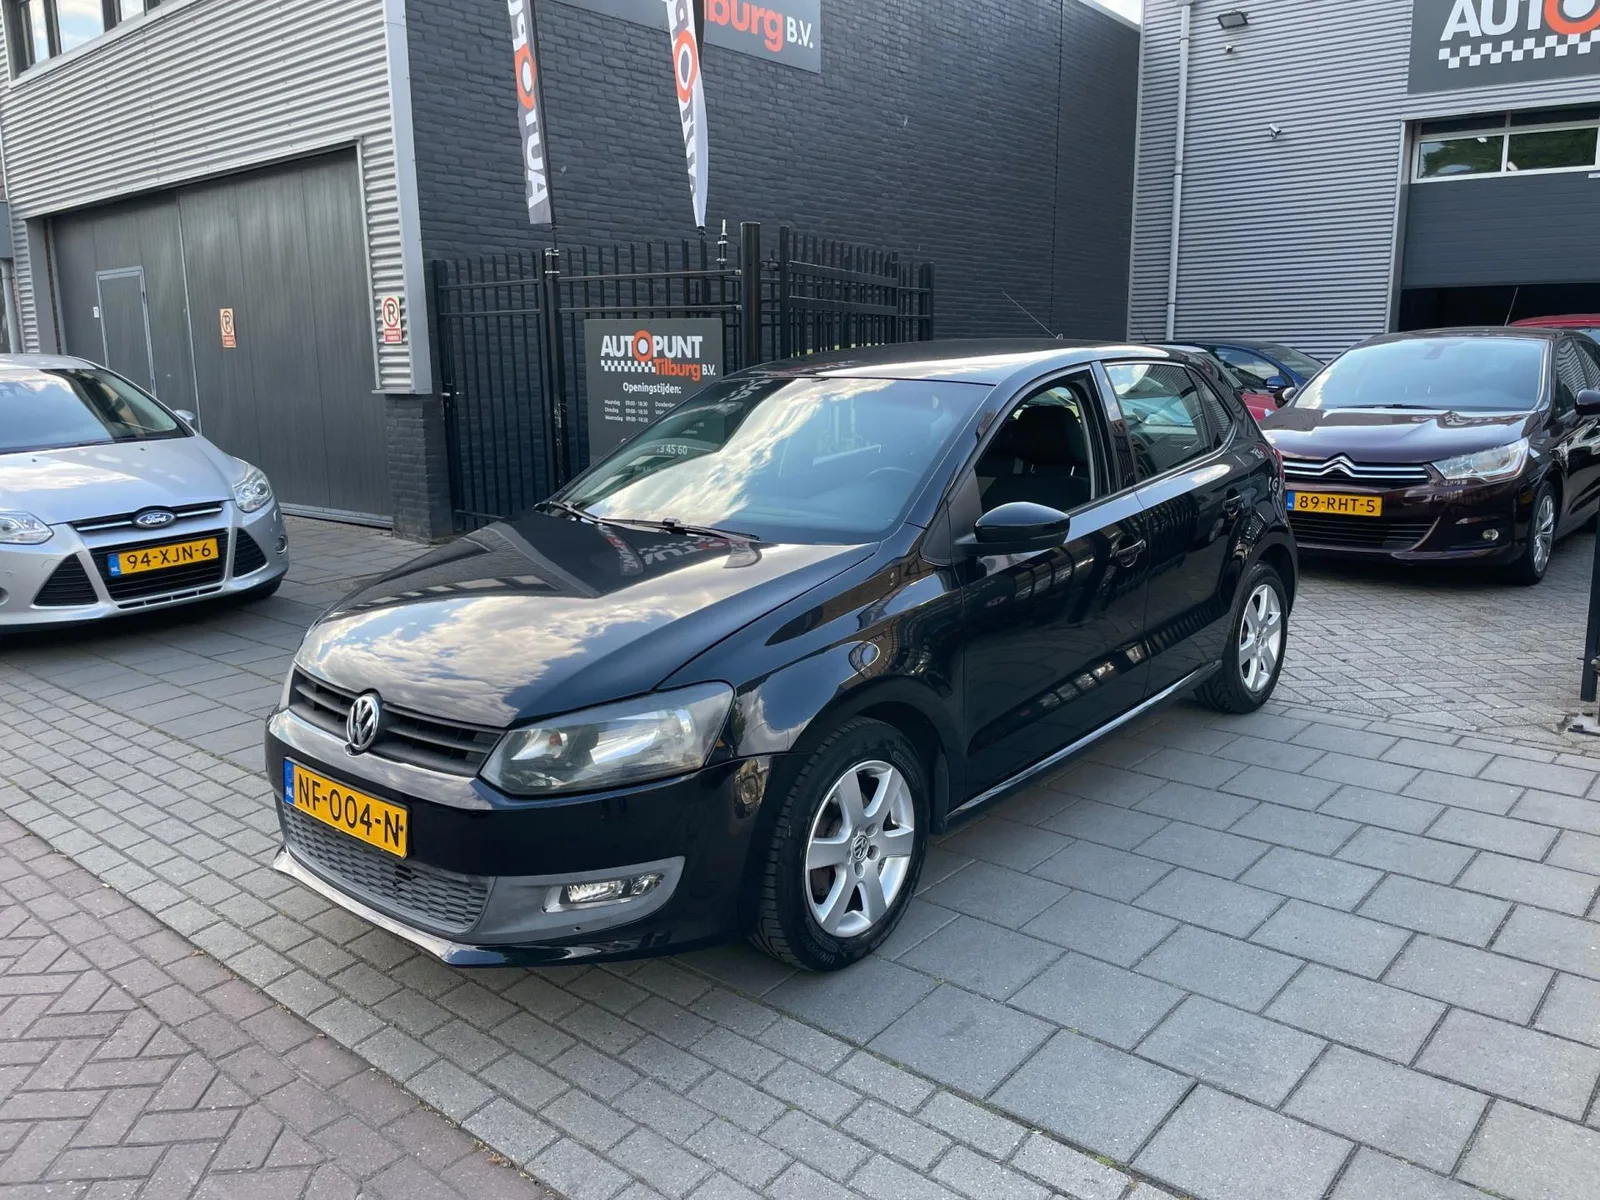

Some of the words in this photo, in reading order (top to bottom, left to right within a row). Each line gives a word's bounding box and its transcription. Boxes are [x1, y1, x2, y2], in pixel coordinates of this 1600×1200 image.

[786, 16, 814, 49] B.V.
[600, 329, 703, 362] AUTOPUNT
[653, 358, 701, 381] Tilburg
[702, 364, 716, 376] B.V.
[622, 382, 682, 395] Openingstijden:
[677, 445, 688, 455] 60
[1299, 495, 1376, 513] 89-RHT-5
[126, 542, 212, 570] 94-XJN-6
[286, 786, 294, 798] NL
[298, 772, 401, 848] NF-004-N
